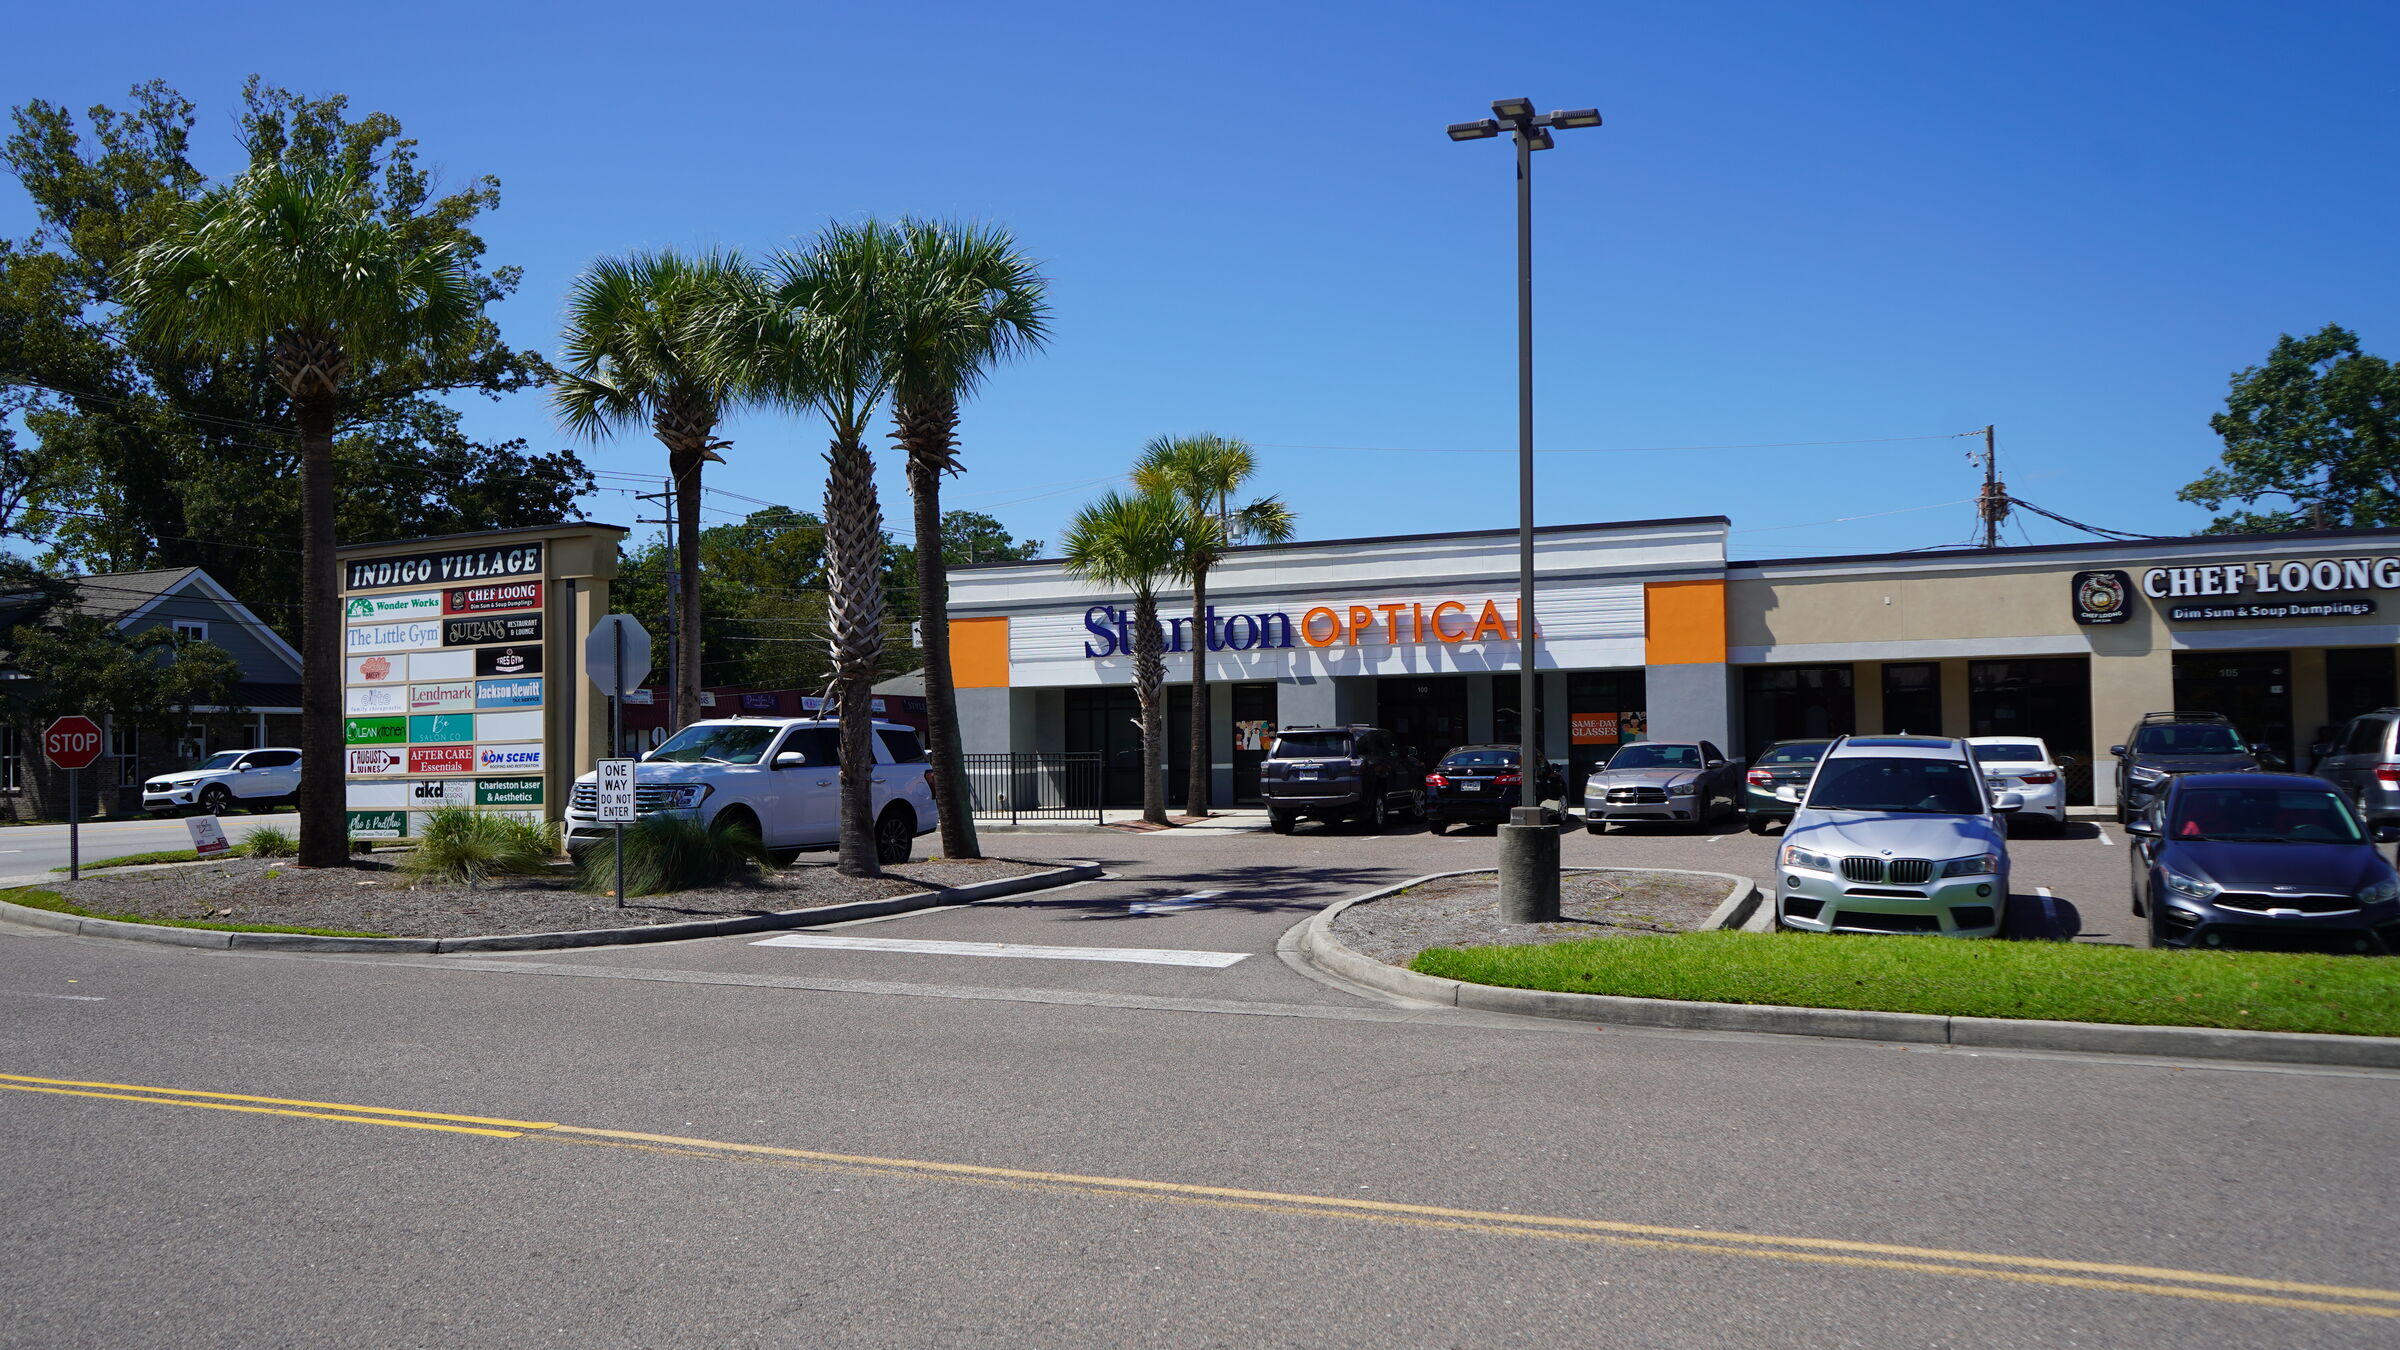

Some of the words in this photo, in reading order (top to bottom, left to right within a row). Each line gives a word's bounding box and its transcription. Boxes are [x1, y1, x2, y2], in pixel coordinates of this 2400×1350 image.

[353, 559, 431, 586] INDIGO
[440, 548, 537, 579] VILLAGE
[2143, 564, 2246, 598] CHEF
[2254, 558, 2400, 593] LOONG
[468, 588, 496, 602] CHEF
[498, 584, 536, 599] LOONG
[376, 601, 409, 610] Wonder
[411, 598, 439, 608] Works
[507, 599, 533, 607] Dumplings
[2173, 608, 2201, 619] Dim
[2203, 607, 2236, 618] Sum
[2237, 606, 2248, 617] &
[2250, 605, 2287, 619] Soup
[2289, 602, 2369, 617] Dumplings
[507, 619, 538, 628] RESTAURANT
[348, 629, 372, 646] The
[374, 626, 406, 645] Little
[408, 624, 438, 646] Gym
[449, 620, 506, 642] SULTAN'S
[515, 628, 534, 636] LOUNGE
[1084, 605, 1295, 658] Stnton
[496, 655, 510, 665] TRES
[510, 655, 524, 665] GYM
[411, 685, 471, 701] Lendmark
[478, 684, 511, 699] Jackson
[1571, 719, 1617, 728] SAME-DAY
[419, 733, 446, 742] SALON
[449, 733, 461, 741] CO
[1571, 727, 1618, 737] GLASSES
[49, 733, 98, 753] STOP
[357, 750, 381, 764] AUGUST
[411, 750, 444, 760] AFTER
[445, 749, 472, 759] CARE
[489, 753, 504, 763] ON
[506, 752, 540, 763] SCENE
[357, 765, 381, 773] WINES
[421, 761, 462, 772] Essentials
[605, 765, 627, 776] ONE
[479, 781, 519, 790] Charleston
[520, 780, 540, 789] Laser
[604, 779, 628, 791] WAY
[487, 793, 493, 802] &
[494, 792, 532, 801] Aesthetics
[601, 794, 615, 804] DO
[616, 794, 631, 804] NOT
[603, 806, 629, 817] ENTER
